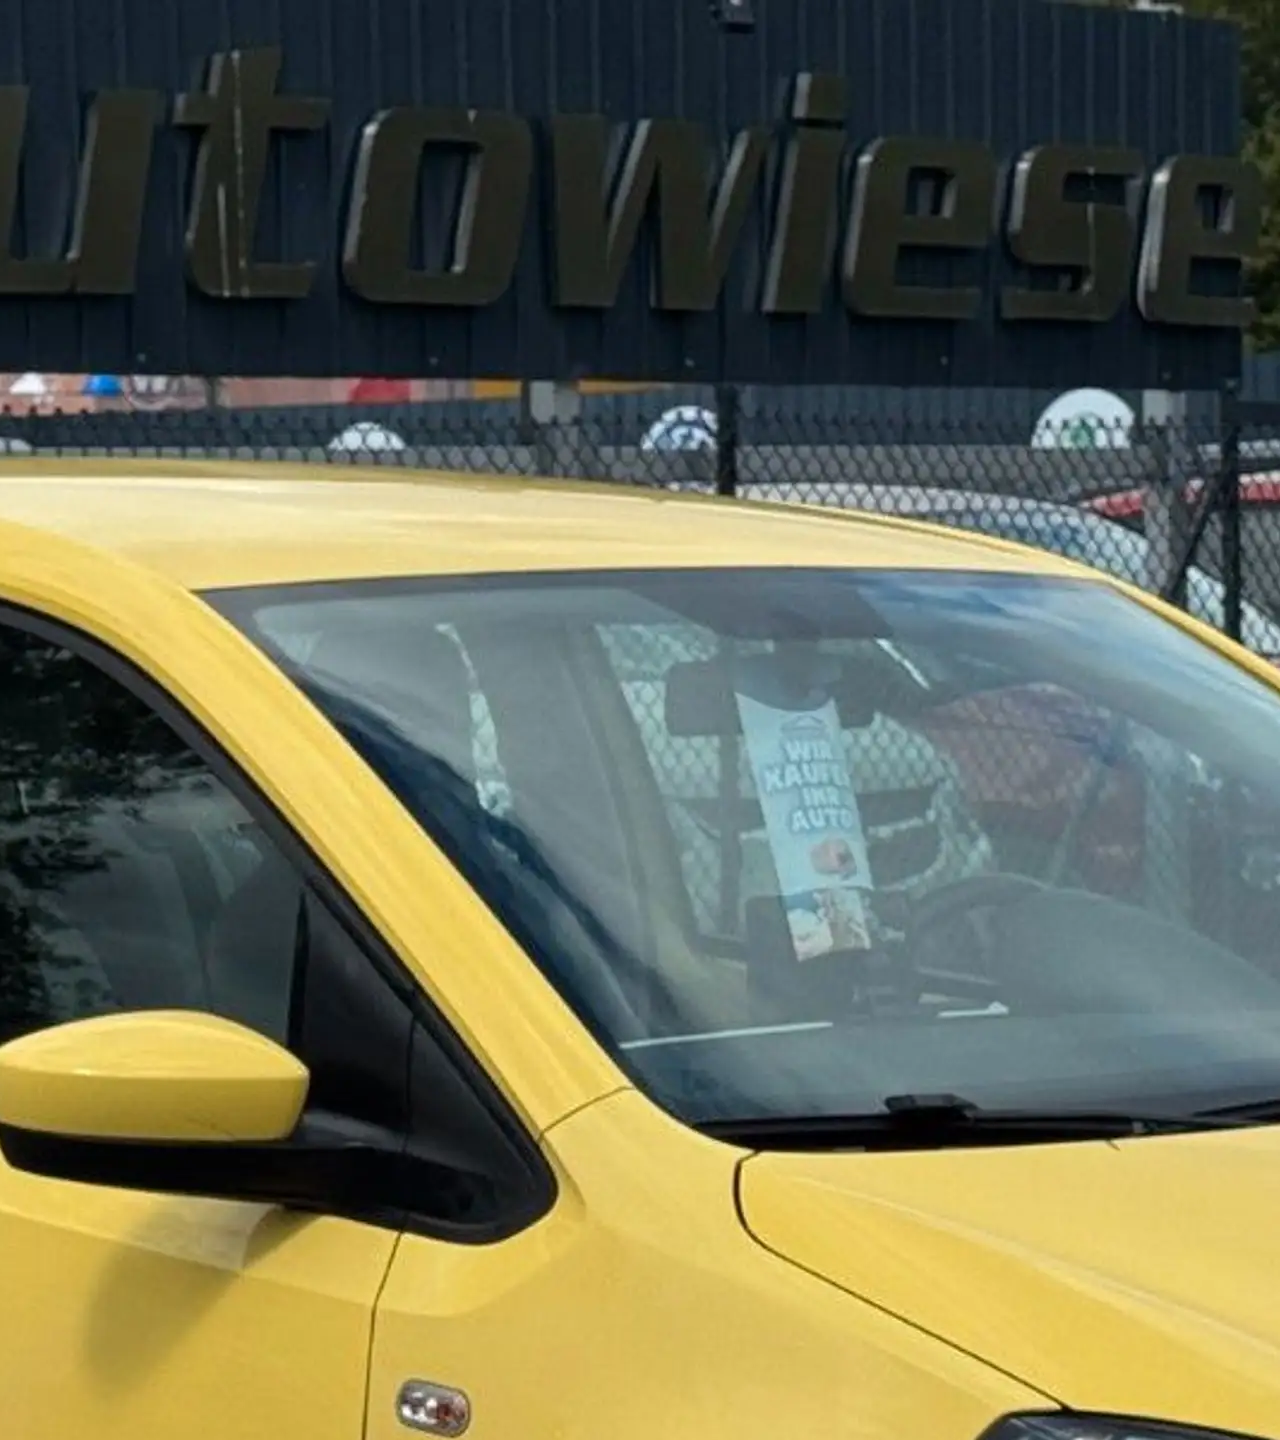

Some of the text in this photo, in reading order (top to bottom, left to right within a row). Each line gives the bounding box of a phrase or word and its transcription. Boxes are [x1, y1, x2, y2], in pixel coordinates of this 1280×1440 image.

[784, 740, 834, 762] WIR
[802, 785, 841, 807] IHR
[790, 806, 853, 832] AUTO
